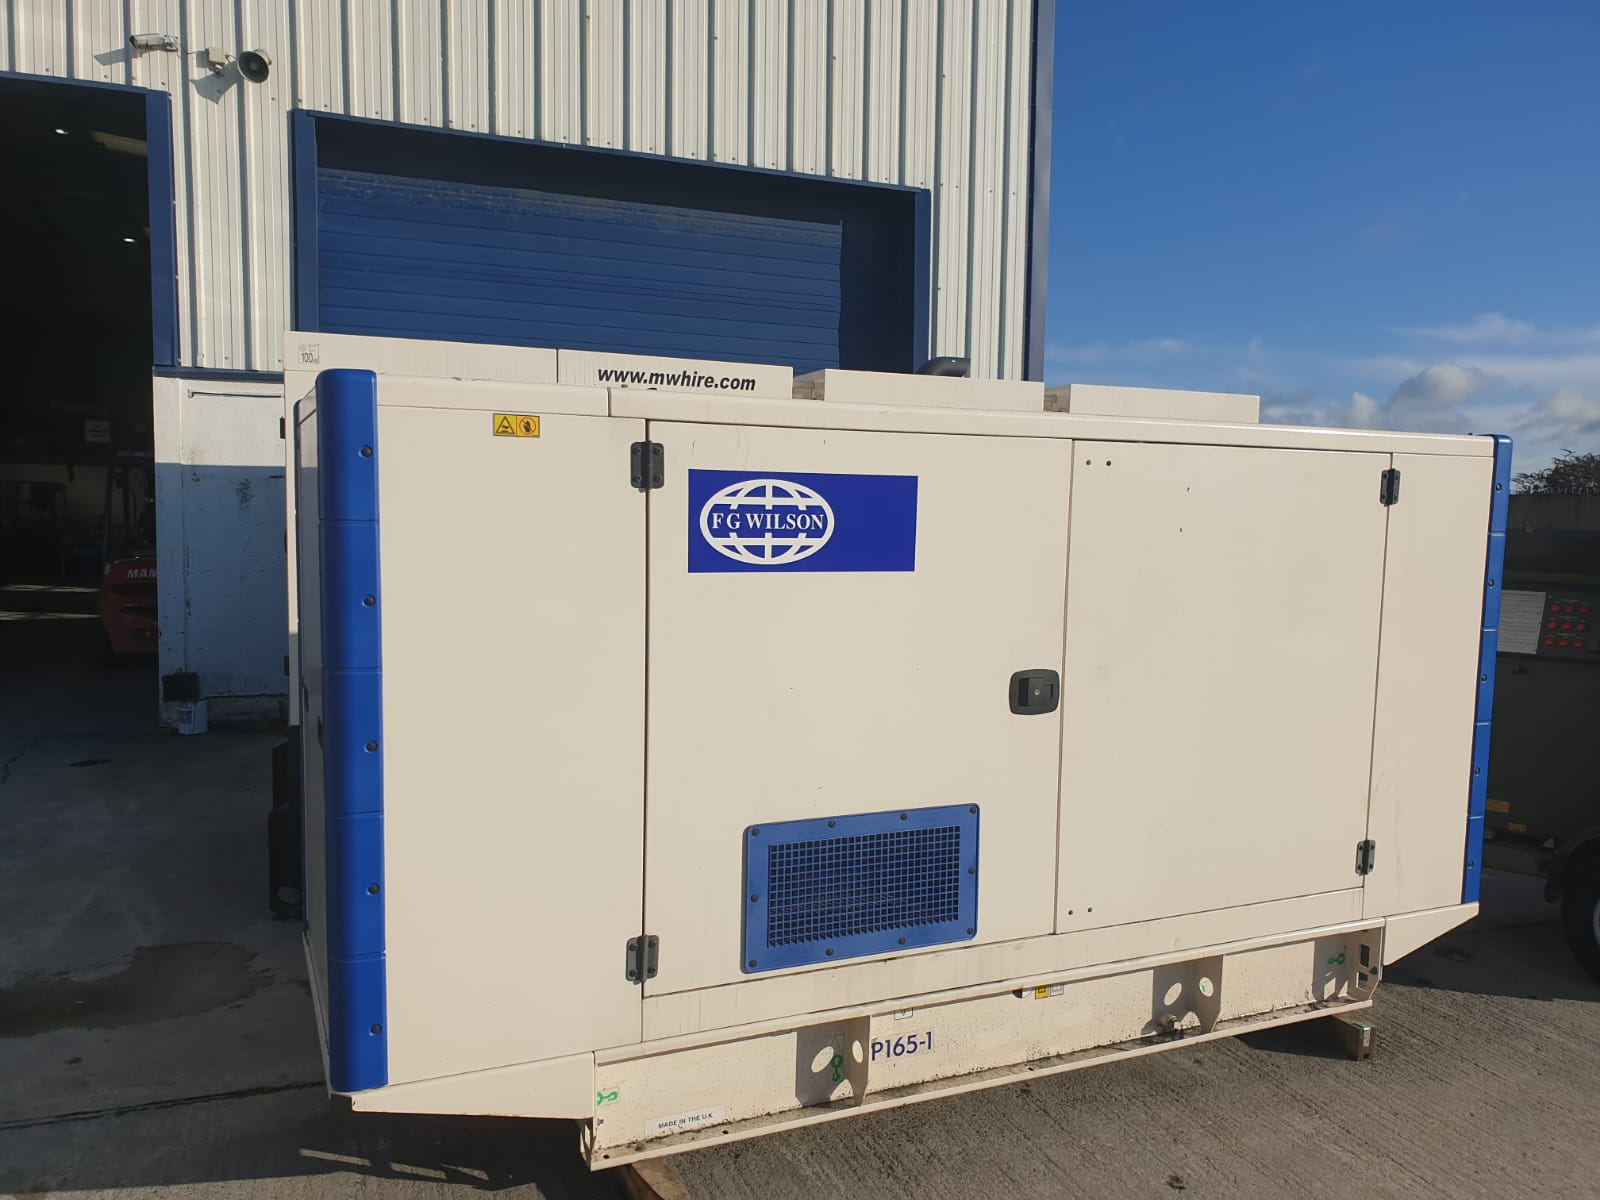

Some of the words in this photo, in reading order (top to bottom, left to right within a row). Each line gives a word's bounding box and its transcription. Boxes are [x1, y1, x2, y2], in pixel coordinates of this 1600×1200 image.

[598, 368, 756, 391] www.mwhire.com
[745, 513, 824, 530] WILSON
[871, 1031, 932, 1061] P165-1
[658, 1119, 678, 1128] MADE
[688, 1115, 701, 1123] THE
